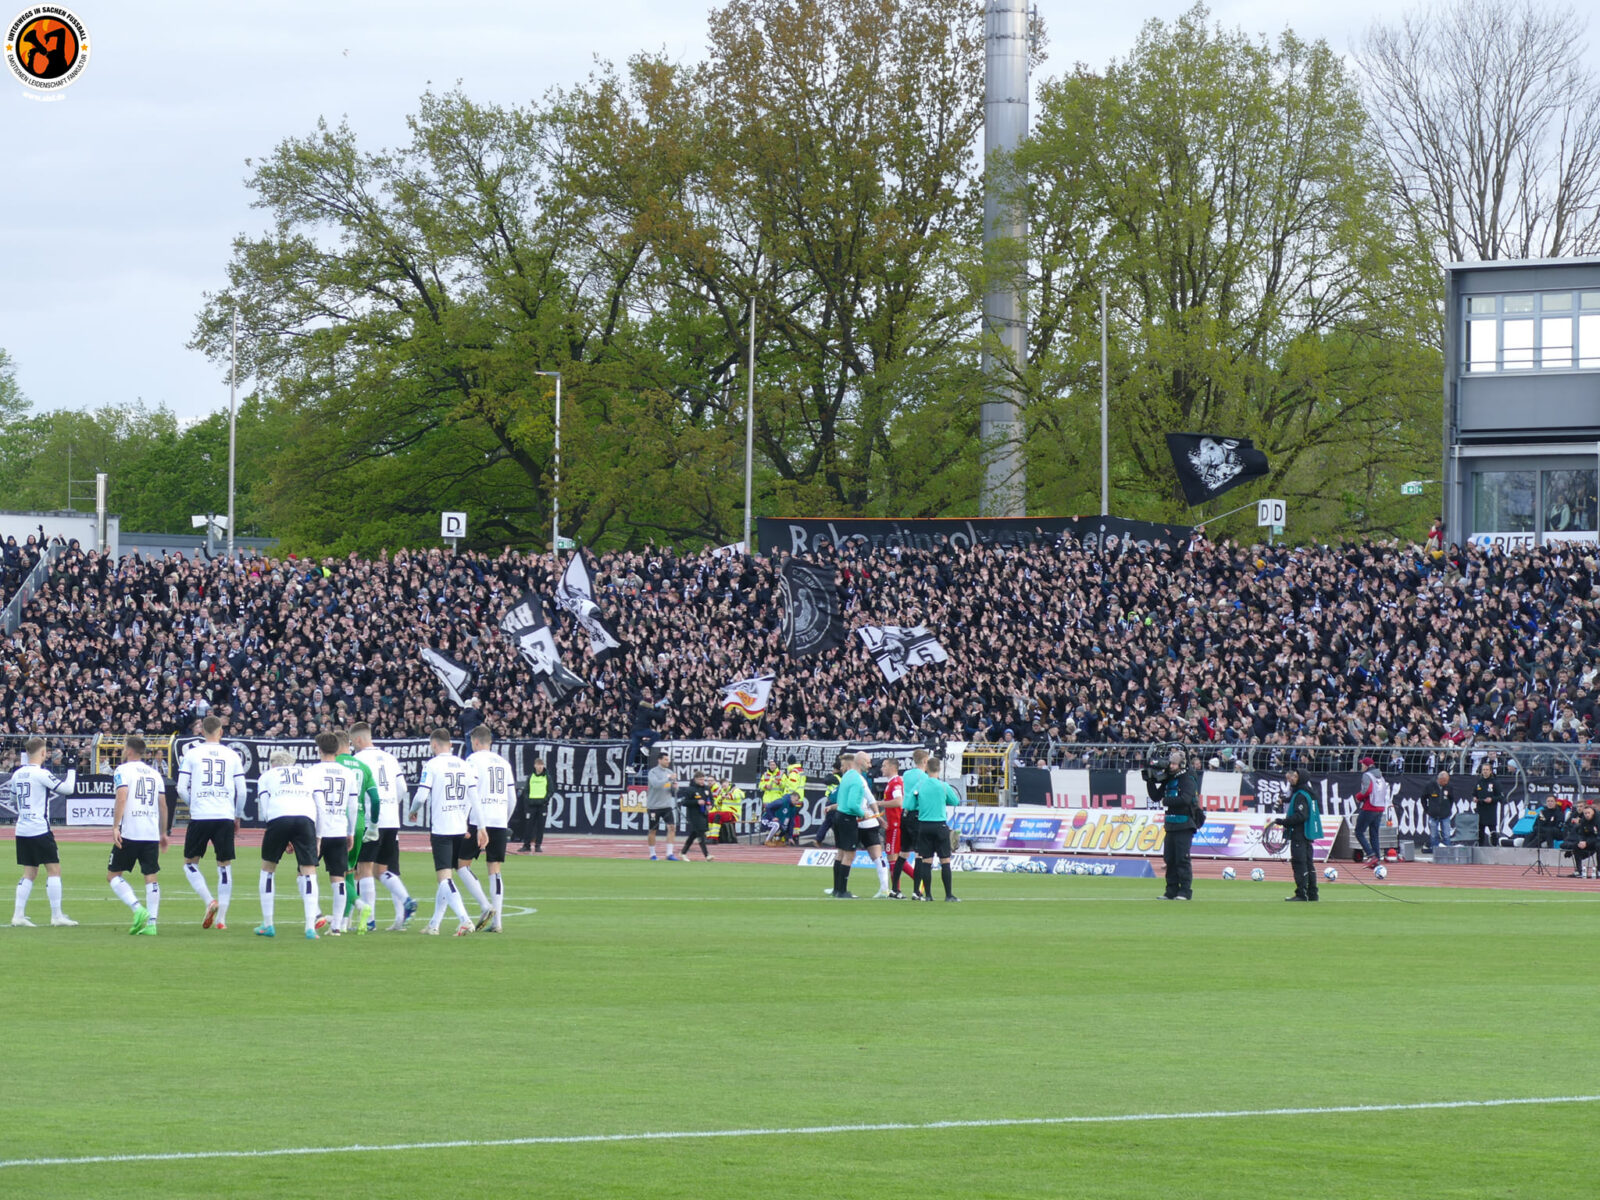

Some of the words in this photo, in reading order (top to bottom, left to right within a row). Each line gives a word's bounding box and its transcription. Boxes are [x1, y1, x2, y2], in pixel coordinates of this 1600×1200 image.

[447, 516, 460, 532] D
[1261, 504, 1269, 521] D
[1274, 504, 1283, 521] D
[201, 758, 226, 787] 33
[379, 764, 389, 791] 4
[444, 772, 466, 801] 26
[488, 766, 505, 794] 18
[76, 781, 115, 794] ULME
[134, 776, 155, 806] 43
[323, 776, 345, 806] 23
